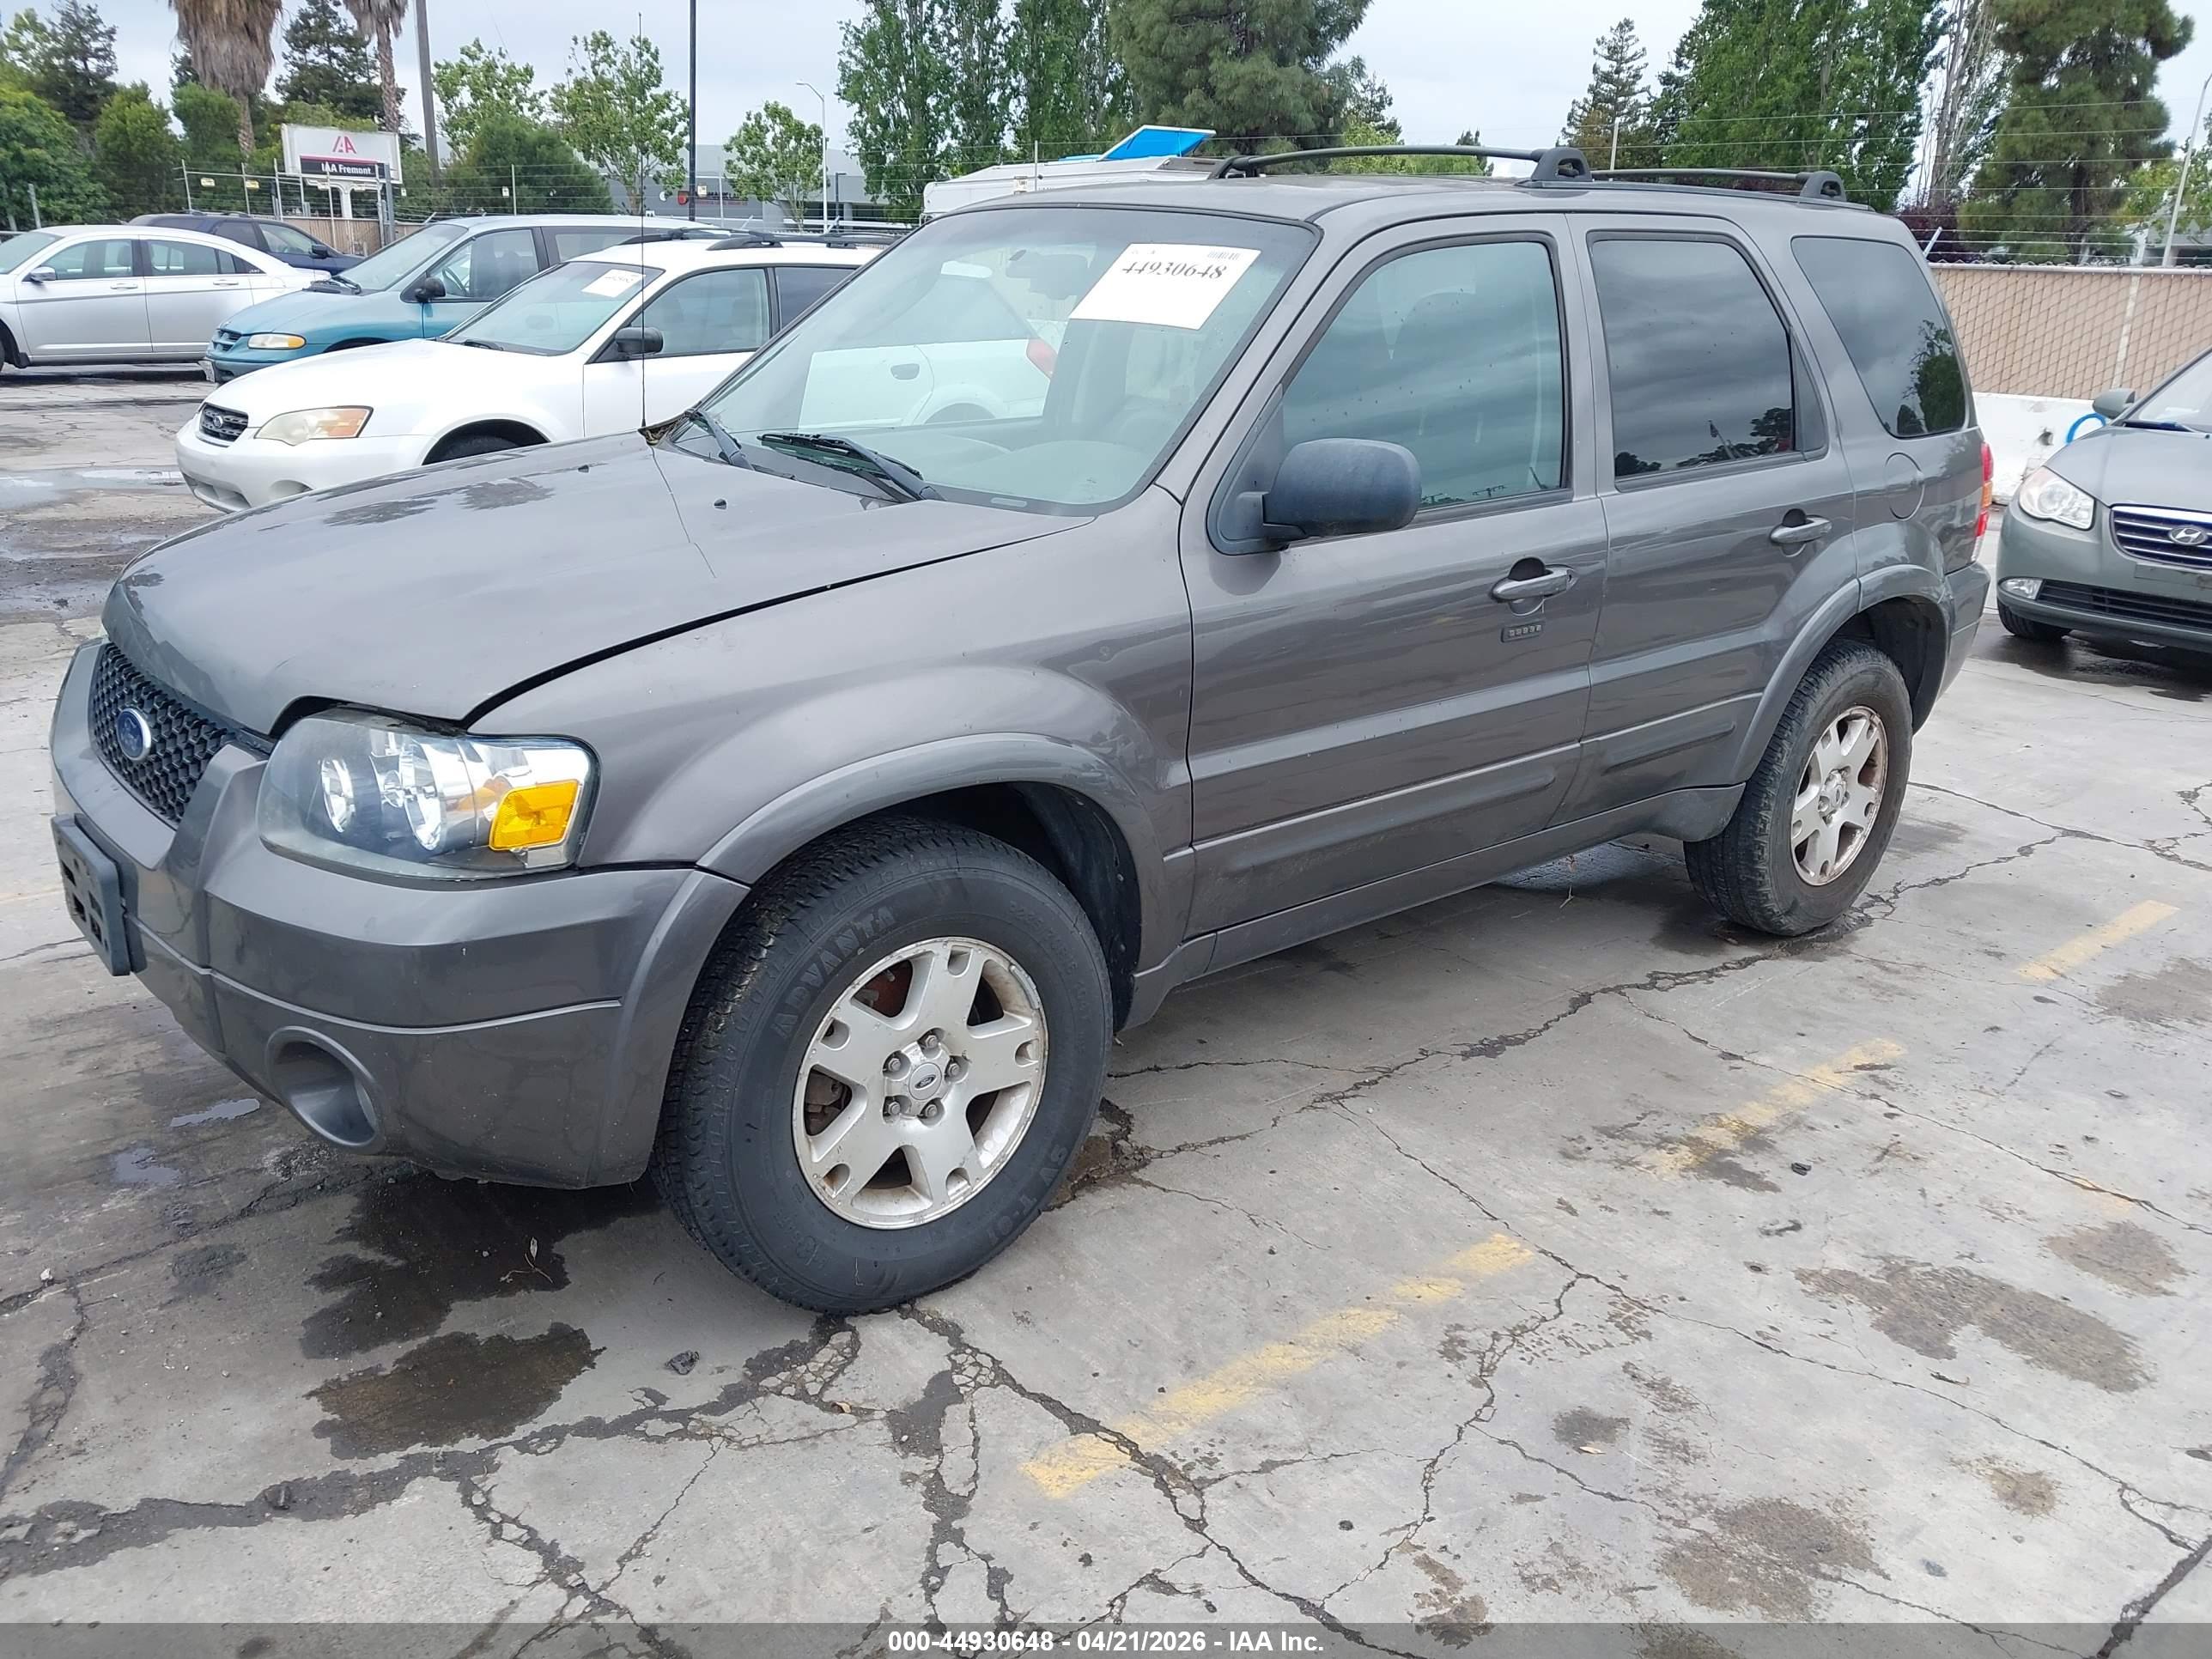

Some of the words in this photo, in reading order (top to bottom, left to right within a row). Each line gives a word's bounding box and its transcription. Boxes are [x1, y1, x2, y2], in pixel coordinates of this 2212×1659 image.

[338, 164, 372, 175] Fremont
[1122, 261, 1227, 279] 44930648
[771, 906, 895, 1039] ADVANTA
